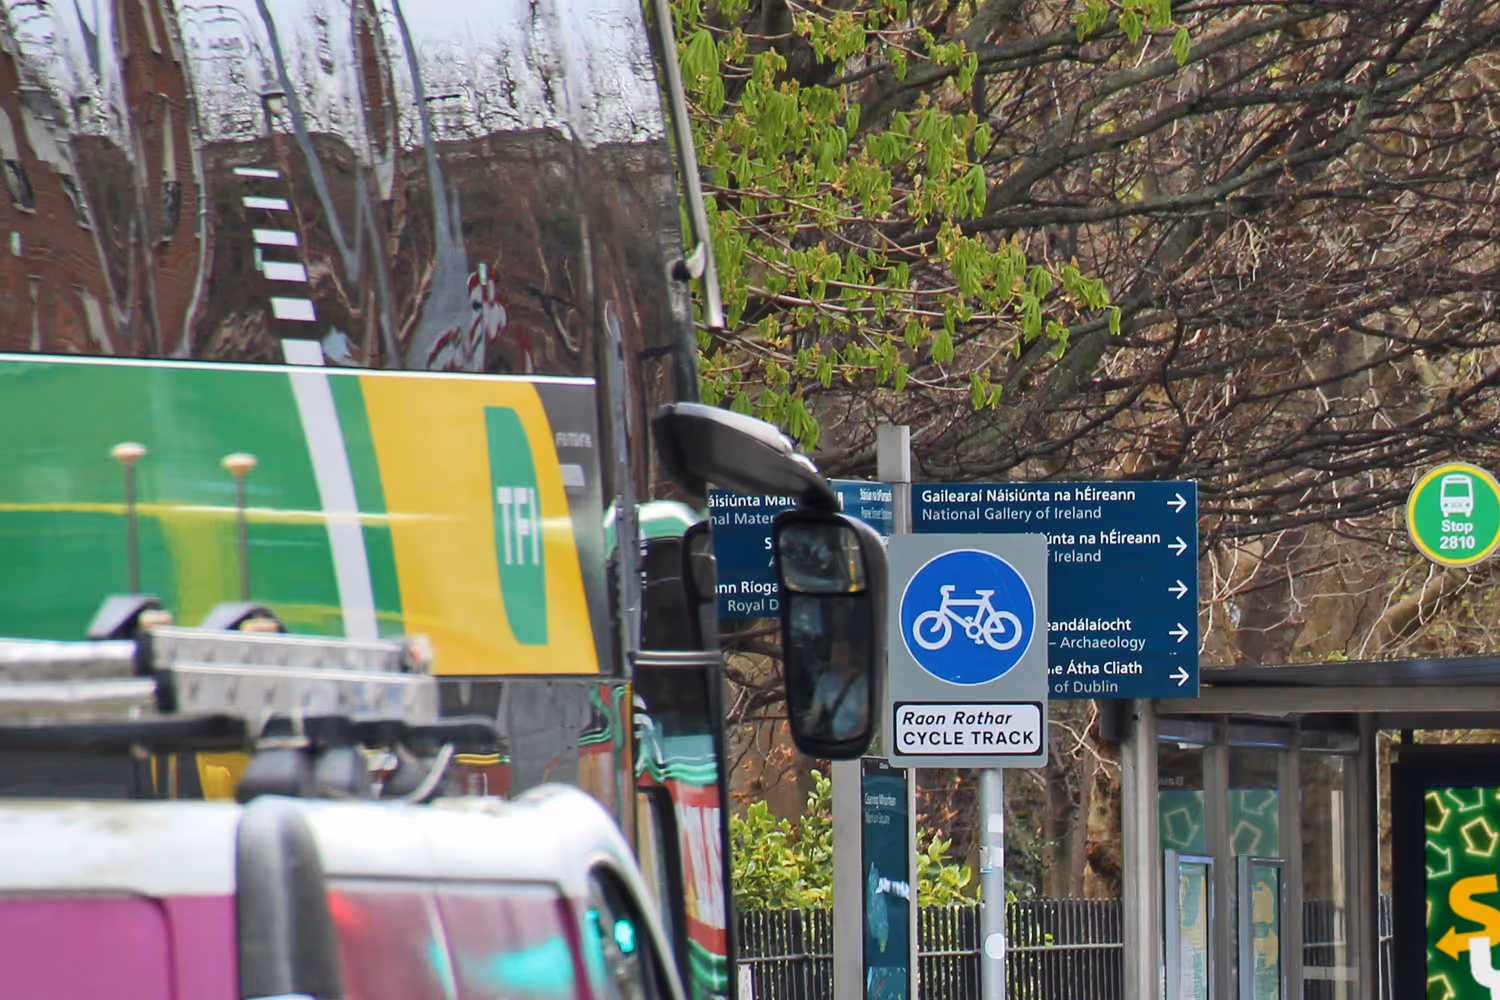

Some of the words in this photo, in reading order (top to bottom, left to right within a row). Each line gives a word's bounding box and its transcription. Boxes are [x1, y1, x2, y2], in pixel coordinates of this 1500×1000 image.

[707, 494, 760, 507] áisiúnta
[922, 489, 982, 503] Gailearaí
[987, 488, 1050, 503] Náisiúnta
[1055, 491, 1071, 502] na
[1075, 486, 1136, 501] hÉireann
[922, 507, 980, 521] National
[984, 507, 1032, 523] Gallery
[1036, 506, 1050, 520] of
[1054, 506, 1102, 519] Ireland
[497, 487, 540, 565] TFI
[1441, 520, 1473, 535] Stop
[1080, 533, 1096, 544] na
[1100, 529, 1161, 544] hÉireann
[1440, 536, 1476, 549] 2810
[1054, 549, 1102, 562] Ireland
[728, 598, 765, 614] Royal
[1047, 617, 1132, 632] eandálaíocht
[1060, 635, 1146, 651] Archaeology
[1066, 660, 1100, 675] Átha
[1103, 661, 1143, 675] Cliath
[1055, 680, 1069, 693] of
[1073, 680, 1118, 693] Dublin
[902, 711, 946, 726] Raon
[953, 711, 1013, 725] Rothar
[903, 731, 964, 746] CYCLE
[971, 730, 1034, 745] TRACK
